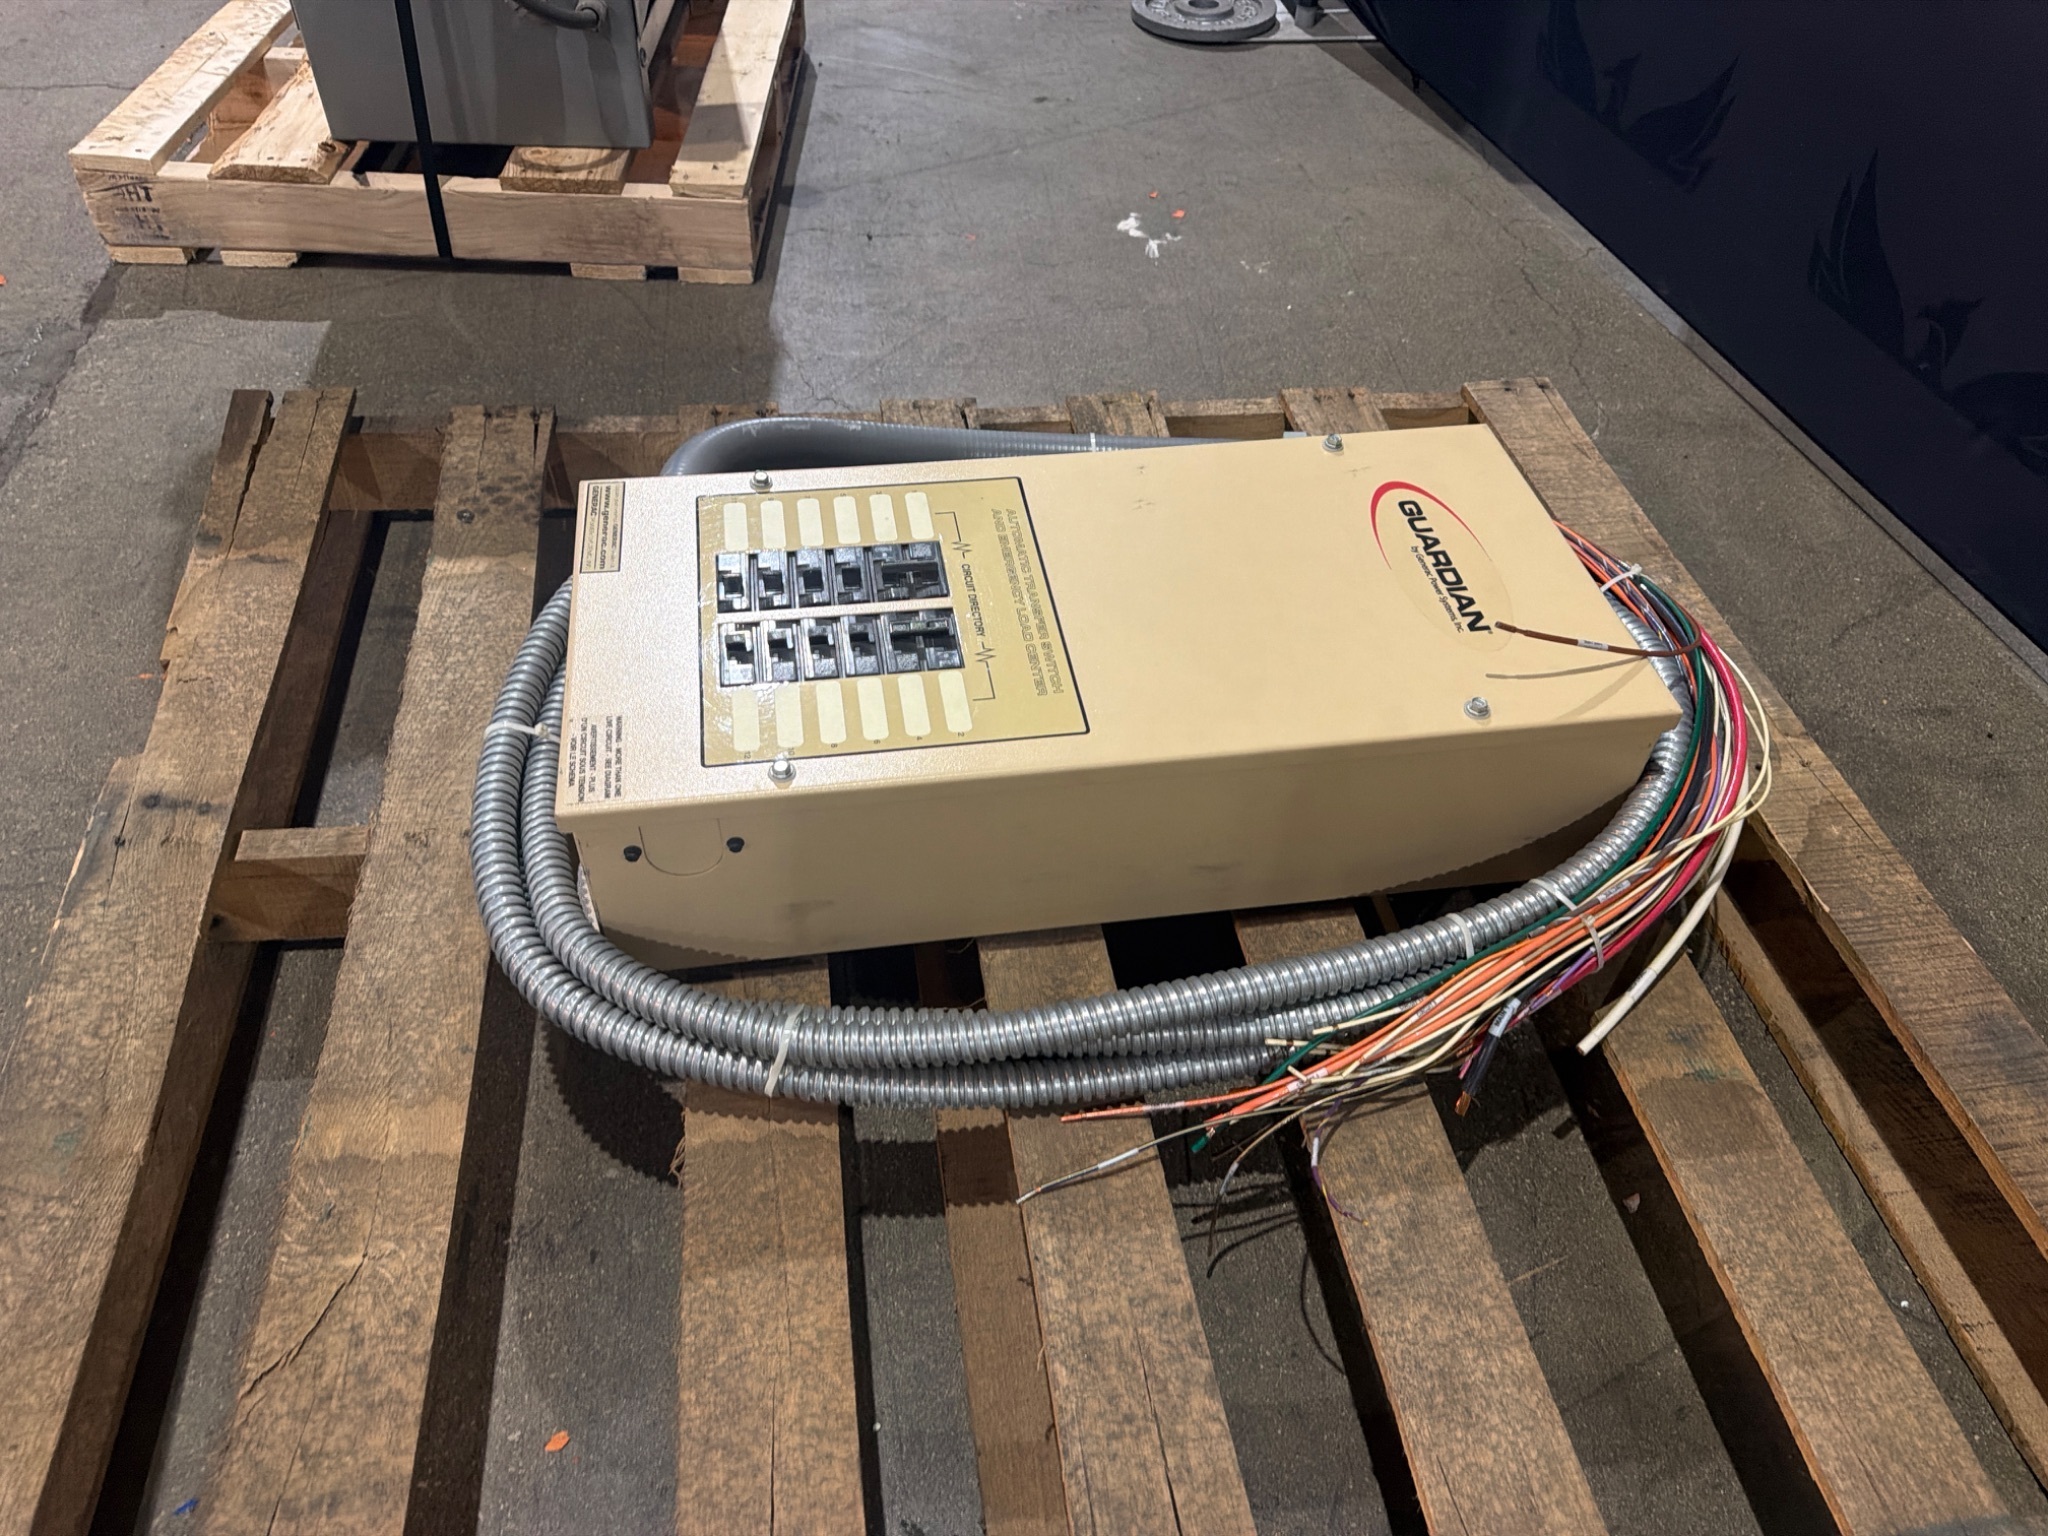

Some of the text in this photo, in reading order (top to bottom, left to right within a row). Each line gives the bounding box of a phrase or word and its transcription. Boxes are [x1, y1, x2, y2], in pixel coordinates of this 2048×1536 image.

[591, 485, 599, 516] GENERAC
[599, 485, 611, 570] www.generac.com
[961, 563, 986, 637] CIRCUIT DIRECTORY
[991, 508, 1048, 696] AND EMERGENCY LOAD CENTER
[1006, 508, 1064, 694] AUTOMATIC TRANSFER SWITCH
[1398, 500, 1492, 633] GUARDIAN
[1410, 545, 1419, 553] by
[1415, 553, 1433, 577] Generac
[1429, 577, 1444, 596] Power
